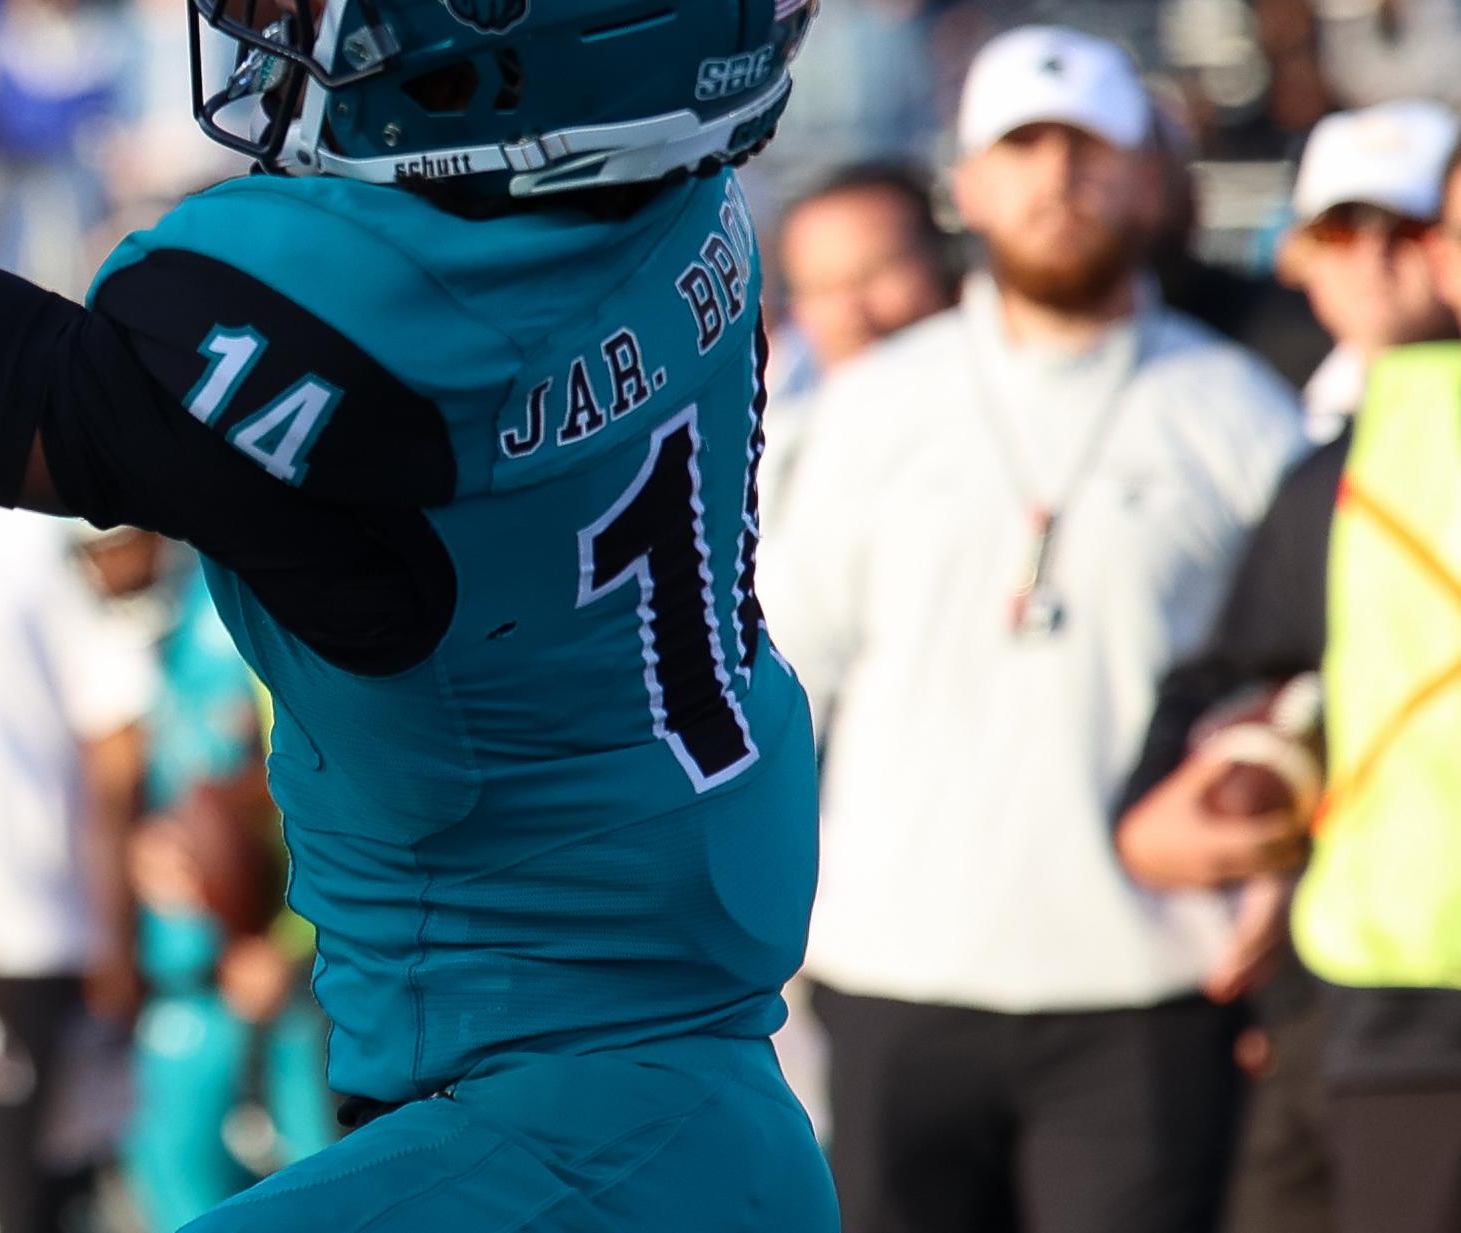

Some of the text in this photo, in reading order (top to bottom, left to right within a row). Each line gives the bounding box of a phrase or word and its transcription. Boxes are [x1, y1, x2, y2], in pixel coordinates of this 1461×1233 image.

[695, 43, 775, 101] SBC
[181, 322, 346, 488] 14
[500, 326, 666, 459] JAR.
